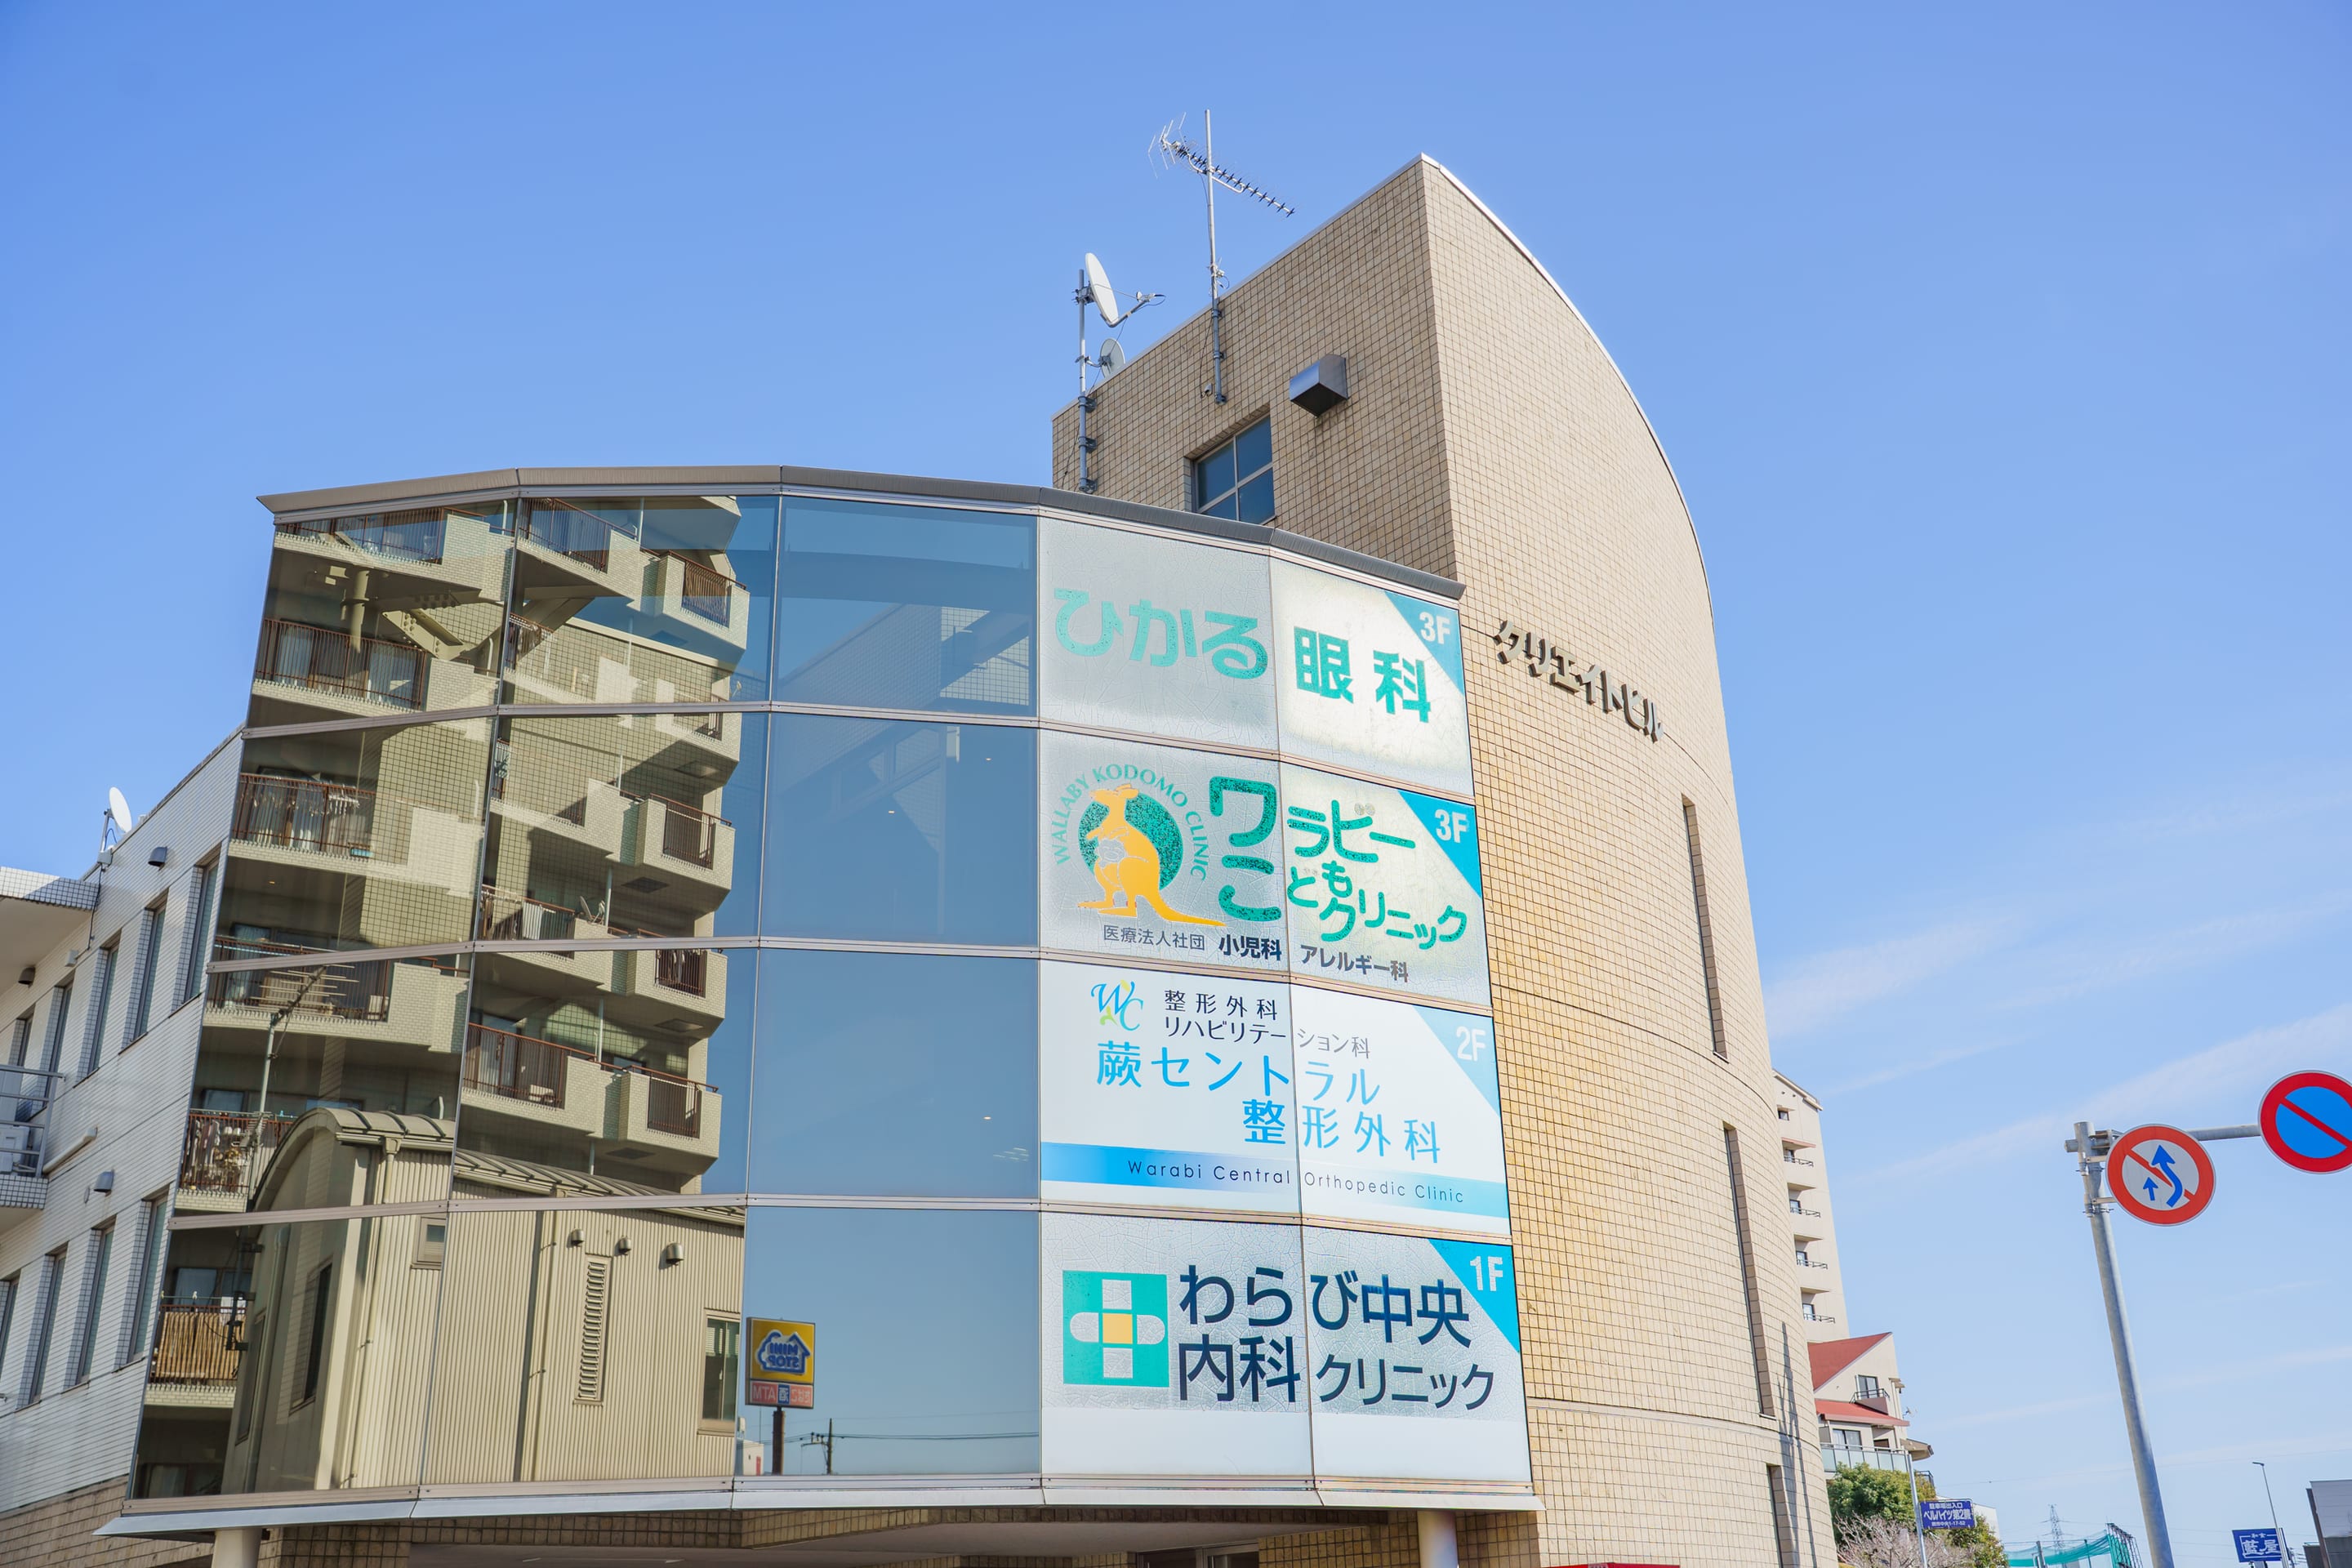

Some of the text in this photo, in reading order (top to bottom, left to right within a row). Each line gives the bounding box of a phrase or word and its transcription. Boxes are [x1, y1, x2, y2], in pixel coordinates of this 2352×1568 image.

[1419, 612, 1451, 645] 3F
[1493, 620, 1664, 743] クリエイトビル
[1051, 764, 1209, 881] WALLABY KODOMO CLINIC
[1435, 808, 1468, 844] 3F
[1103, 924, 1409, 983] 医療法人社団 小児科 アレルギー科
[1164, 989, 1278, 1021] 整形外科
[1456, 1026, 1486, 1062] 2F
[1242, 1098, 1441, 1164] 整形外科
[1128, 1160, 1463, 1203] Warabi Central Orthopedic Clinic
[1469, 1256, 1504, 1293] 1F
